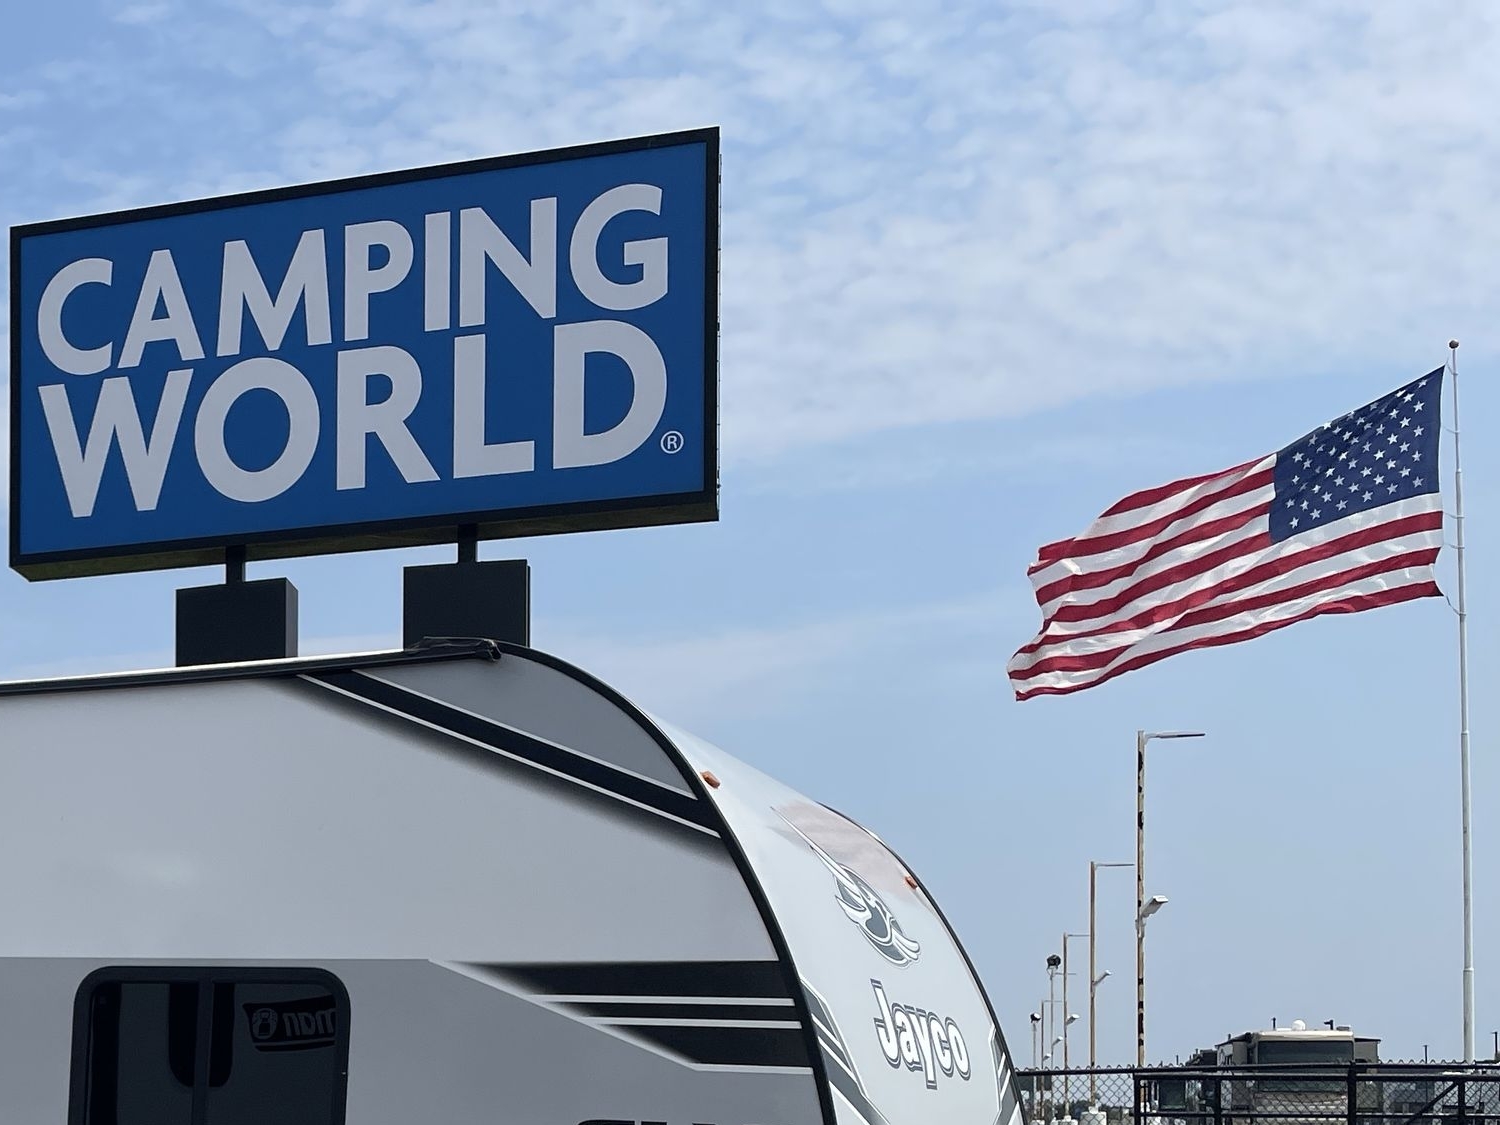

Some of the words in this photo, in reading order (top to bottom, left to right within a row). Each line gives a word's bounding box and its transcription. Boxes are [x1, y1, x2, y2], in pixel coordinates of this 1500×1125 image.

[37, 183, 669, 376] CAMPING
[37, 320, 668, 518] WORLD
[869, 978, 972, 1091] Jayco
